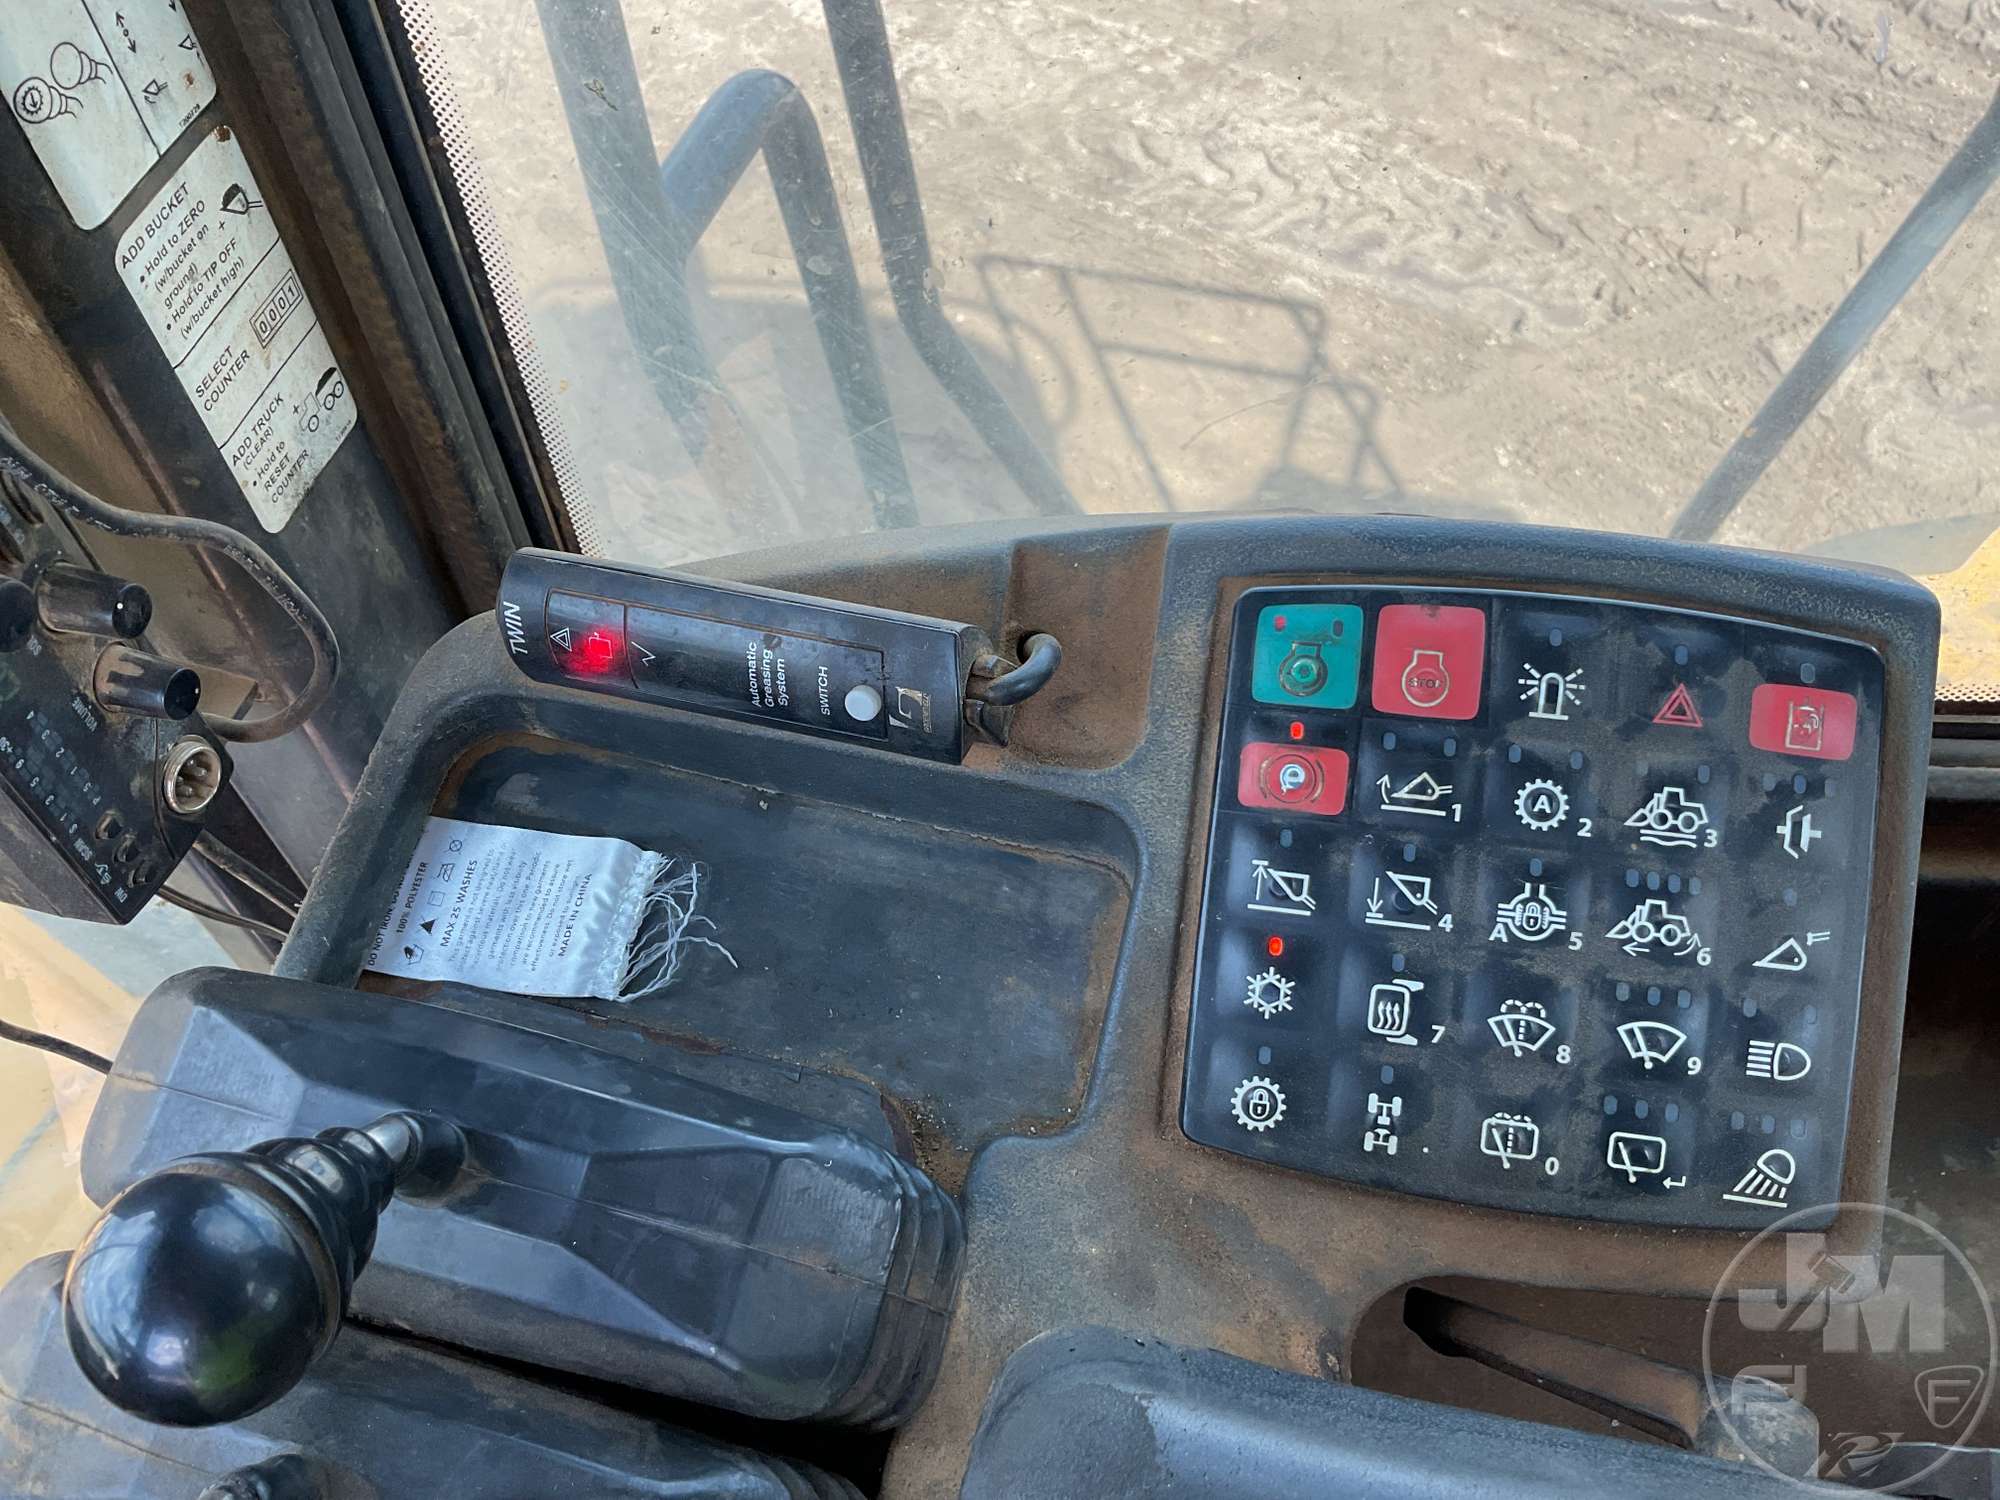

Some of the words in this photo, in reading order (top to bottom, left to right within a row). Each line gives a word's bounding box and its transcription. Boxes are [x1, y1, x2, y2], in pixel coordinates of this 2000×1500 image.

[122, 236, 145, 269] ADD
[145, 182, 187, 238] BUCKET
[145, 244, 168, 275] Hold
[168, 234, 179, 248] to
[178, 200, 205, 235] ZERO
[155, 238, 196, 292] (w/bucket
[196, 224, 209, 240] on
[172, 293, 193, 323] Hold
[193, 282, 204, 296] to
[203, 261, 217, 281] TIP
[219, 238, 236, 263] OFF
[164, 262, 198, 309] ground)
[181, 284, 222, 339] (w/bucket
[220, 256, 244, 286] high)
[196, 346, 232, 397] SELECT
[204, 350, 249, 411] COUNTER
[232, 436, 252, 466] ADD
[252, 393, 283, 435] TRUCK
[243, 426, 273, 469] (CLEAR)
[257, 452, 276, 479] Hold
[276, 441, 285, 453] to
[264, 452, 289, 491] RESET
[272, 450, 308, 503] COUNTER
[503, 601, 528, 654] TWIN
[746, 642, 761, 707] Automatic
[761, 649, 774, 707] Greasing
[776, 659, 789, 706] System
[818, 666, 830, 715] SWITCH
[72, 697, 97, 732] VOLUME
[1451, 803, 1462, 822] 1
[1533, 795, 1551, 814] A
[1576, 818, 1592, 837] 2
[1703, 829, 1718, 848] 3
[405, 862, 427, 909] POLYESTER
[440, 922, 456, 947] MAX
[450, 906, 461, 919] 25
[456, 860, 477, 902] WASHES
[558, 924, 573, 956] MADE
[569, 910, 579, 921] IN
[574, 874, 591, 907] CHINA
[1438, 913, 1453, 932] 4
[1488, 923, 1508, 942] A
[372, 932, 385, 951] NOT
[1568, 932, 1583, 951] 5
[1696, 947, 1712, 966] 6
[1431, 1024, 1446, 1044] 7
[1556, 1044, 1571, 1064] 8
[1687, 1056, 1701, 1076] 9
[1545, 1157, 1560, 1176] 0
